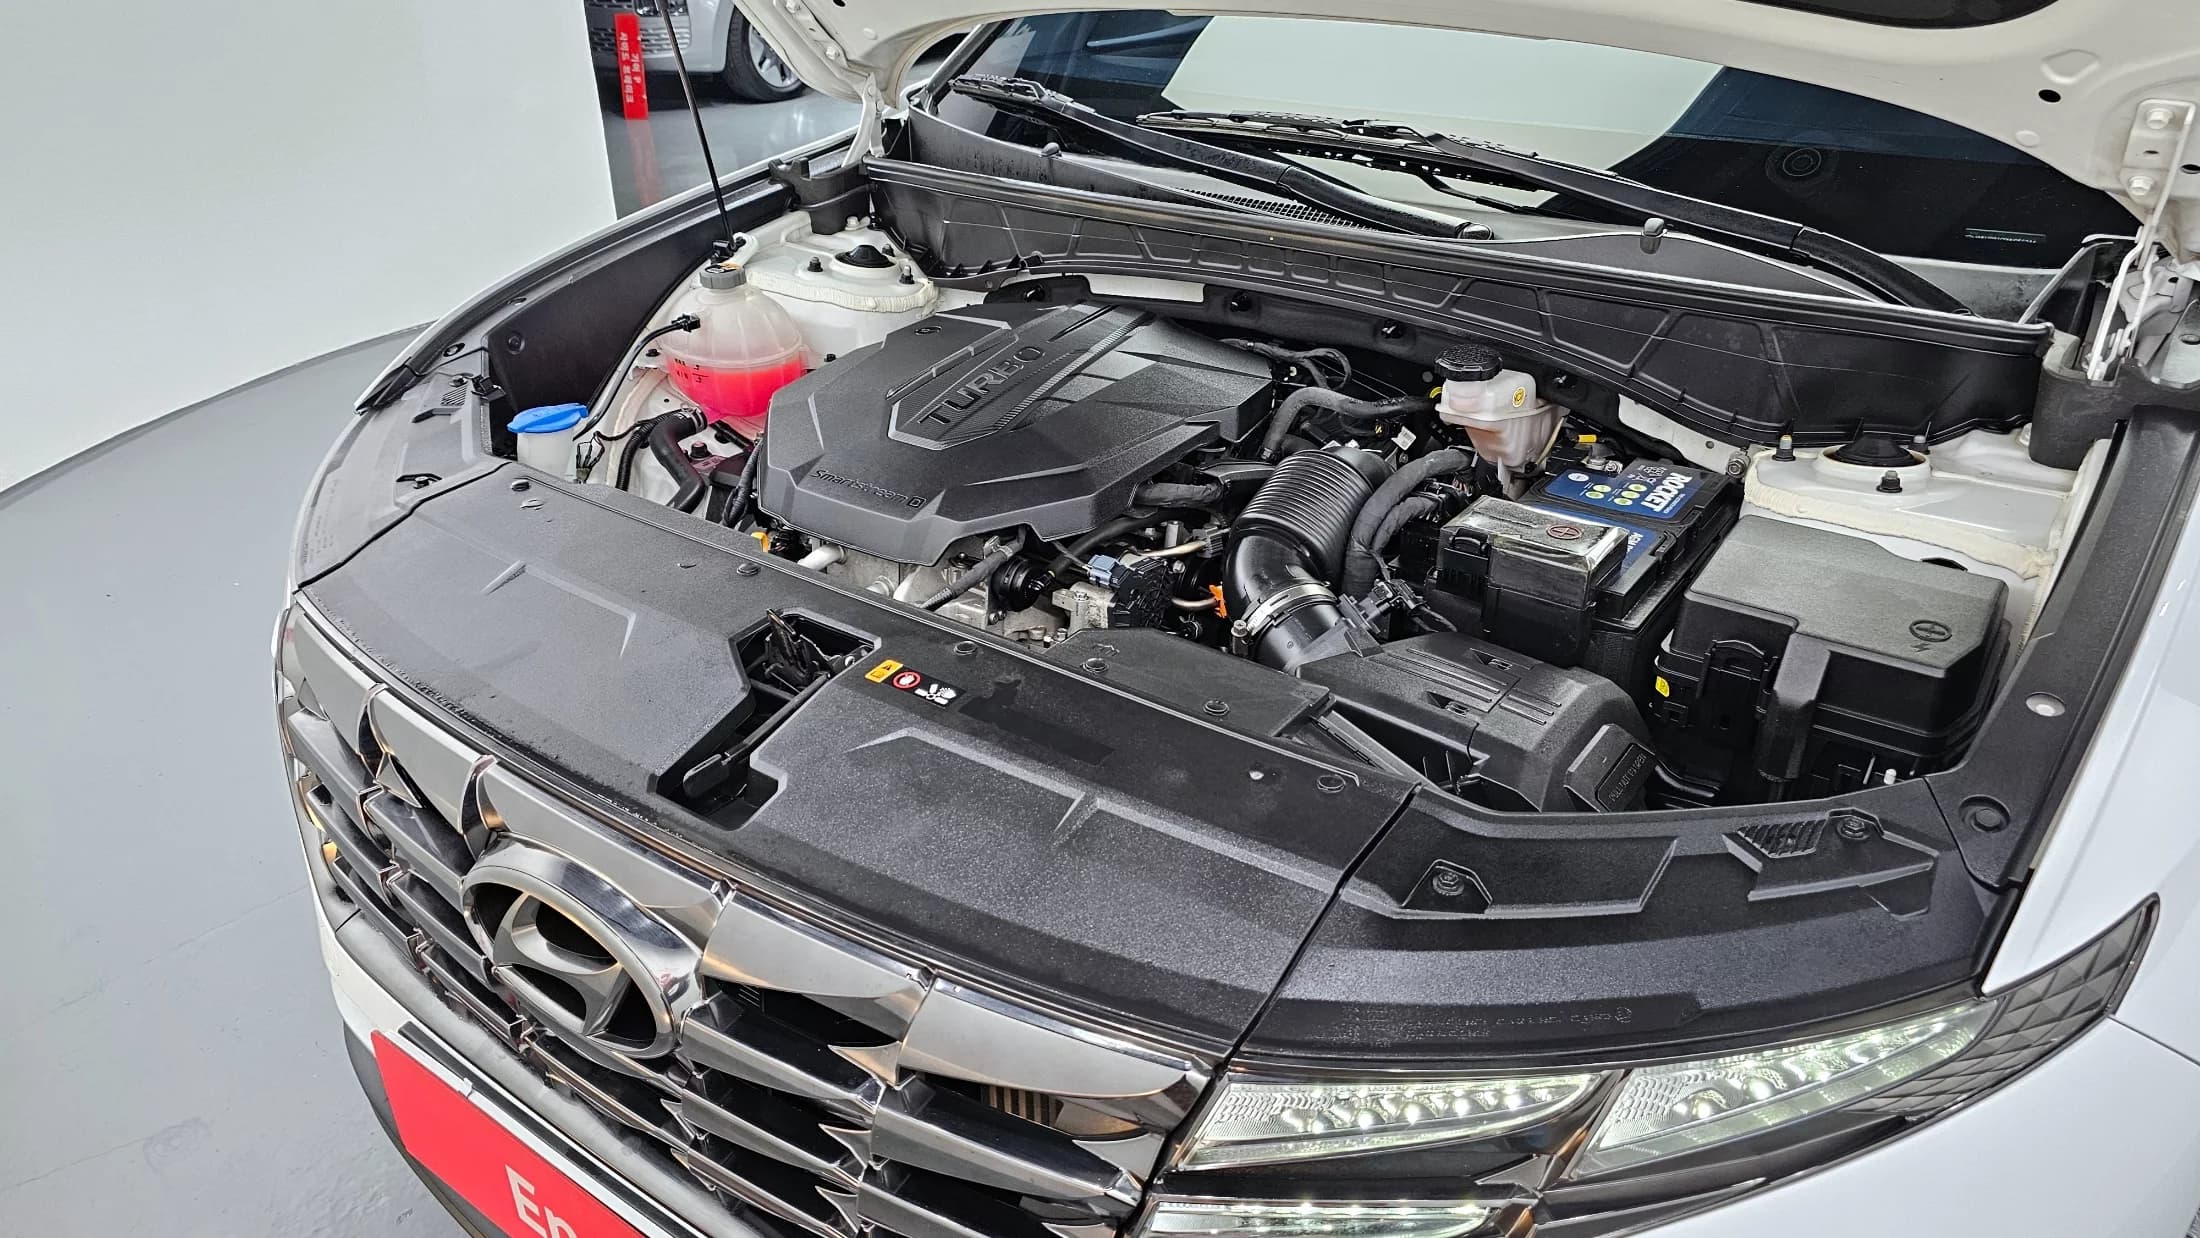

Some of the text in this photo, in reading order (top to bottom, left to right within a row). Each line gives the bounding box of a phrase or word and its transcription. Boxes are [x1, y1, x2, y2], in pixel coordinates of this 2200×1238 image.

[917, 346, 1047, 425] TURBO
[809, 469, 909, 503] Smartstream
[1641, 472, 1693, 513] ROCKET
